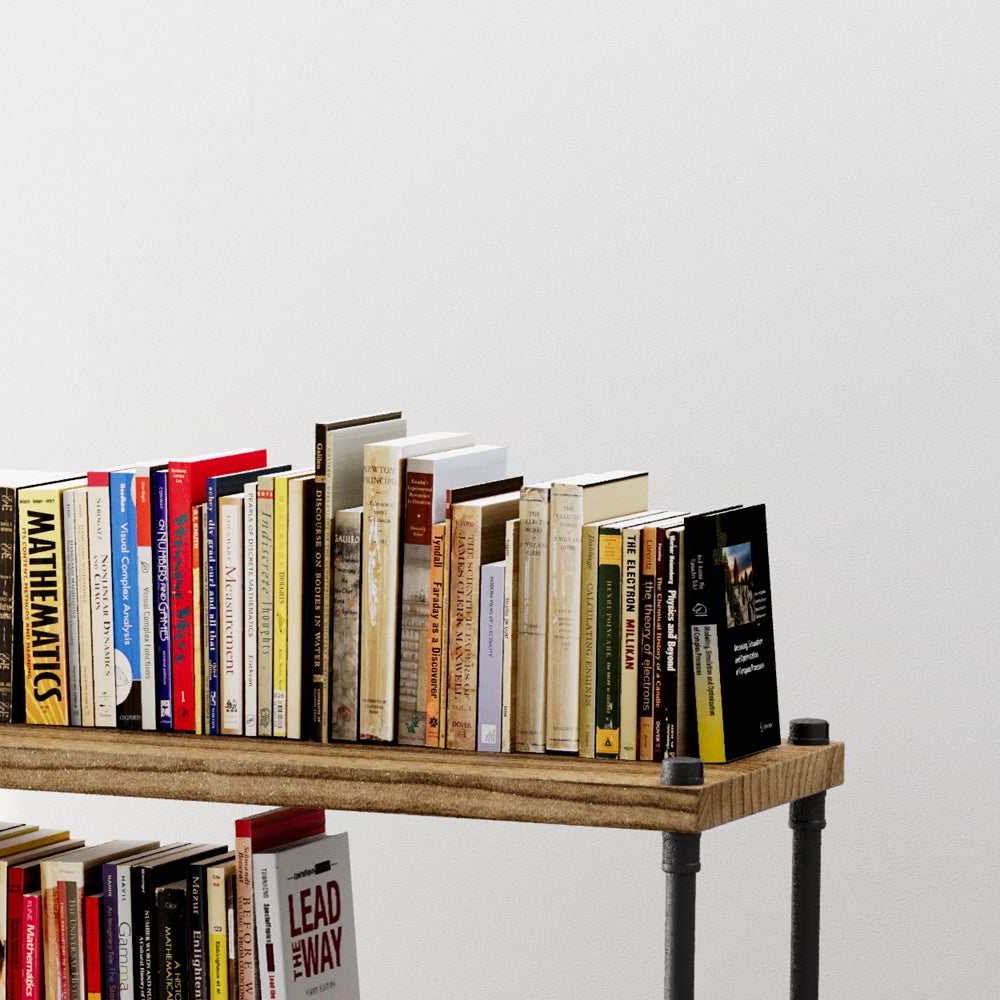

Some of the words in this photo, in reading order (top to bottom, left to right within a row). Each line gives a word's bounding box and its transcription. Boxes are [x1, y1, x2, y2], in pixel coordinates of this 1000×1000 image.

[120, 522, 129, 553] Visual
[261, 512, 271, 594] Indiscrete
[433, 536, 444, 568] Tyndall
[626, 536, 636, 554] THE
[121, 557, 130, 598] Complex
[314, 553, 321, 567] ON
[26, 510, 62, 702] MATHEMATICS
[432, 582, 442, 619] Faraday
[626, 560, 636, 612] ELECTRON
[666, 590, 676, 620] Physics
[122, 604, 131, 645] Analysis
[224, 566, 236, 676] Measurement
[261, 602, 272, 655] Thoughts
[314, 615, 321, 628] IN
[431, 623, 441, 634] as
[666, 624, 676, 639] and
[625, 619, 635, 670] MILLIKAN
[666, 642, 676, 671] Beyond
[430, 648, 441, 699] Discoverer
[288, 880, 341, 938] LEAD
[243, 898, 252, 970] BEFORE
[301, 926, 342, 978] WAY
[25, 924, 35, 996] Mathematics
[118, 922, 132, 991] Gamma
[292, 940, 302, 982] THE
